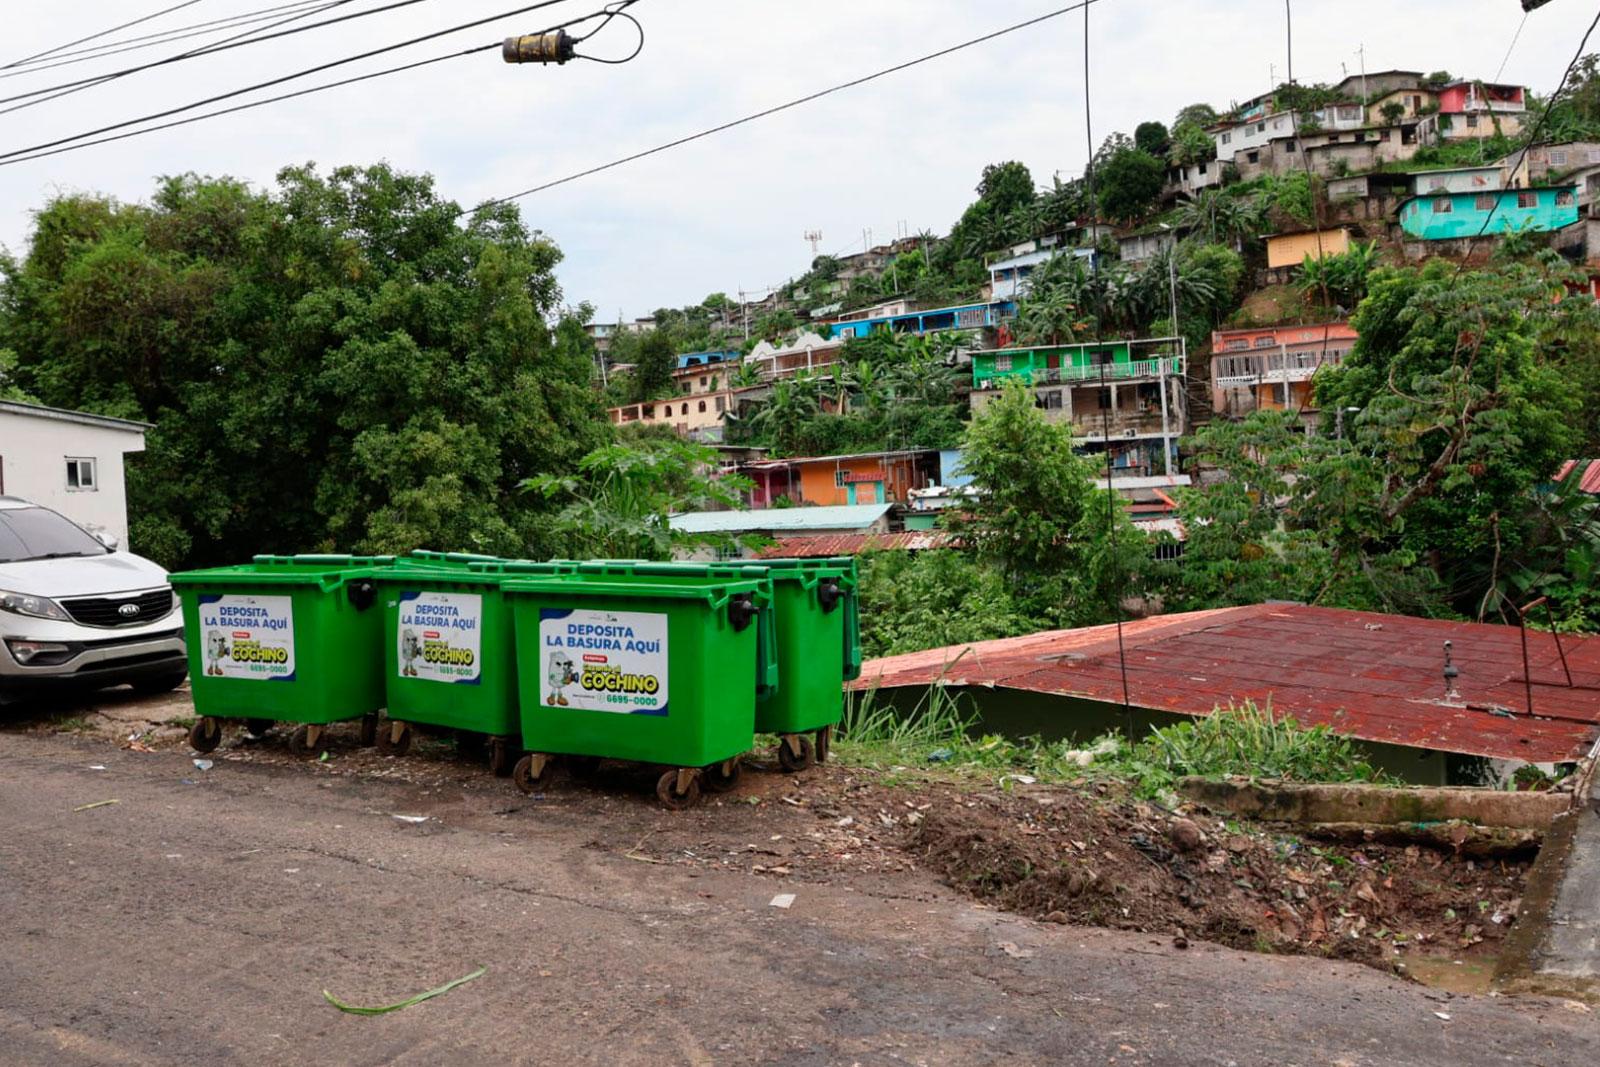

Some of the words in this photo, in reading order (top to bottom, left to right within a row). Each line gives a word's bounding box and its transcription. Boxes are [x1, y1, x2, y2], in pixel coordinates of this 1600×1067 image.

[220, 606, 268, 617] DEPOSITA
[416, 605, 459, 616] DEPOSITA
[205, 617, 217, 626] LA
[220, 617, 260, 628] BASURA
[263, 617, 287, 630] AQUÍ
[402, 615, 412, 624] LA
[414, 616, 449, 627] BASURA
[452, 617, 476, 630] AQUÍ
[568, 624, 634, 638] DEPOSITA
[546, 635, 563, 646] LA
[567, 637, 621, 650] BASURA
[625, 639, 660, 654] AQUÍ
[231, 647, 288, 663] COCHINO
[423, 647, 474, 666] COCHINO
[581, 672, 659, 694] COCHINO
[606, 694, 658, 706] 6695-0000
